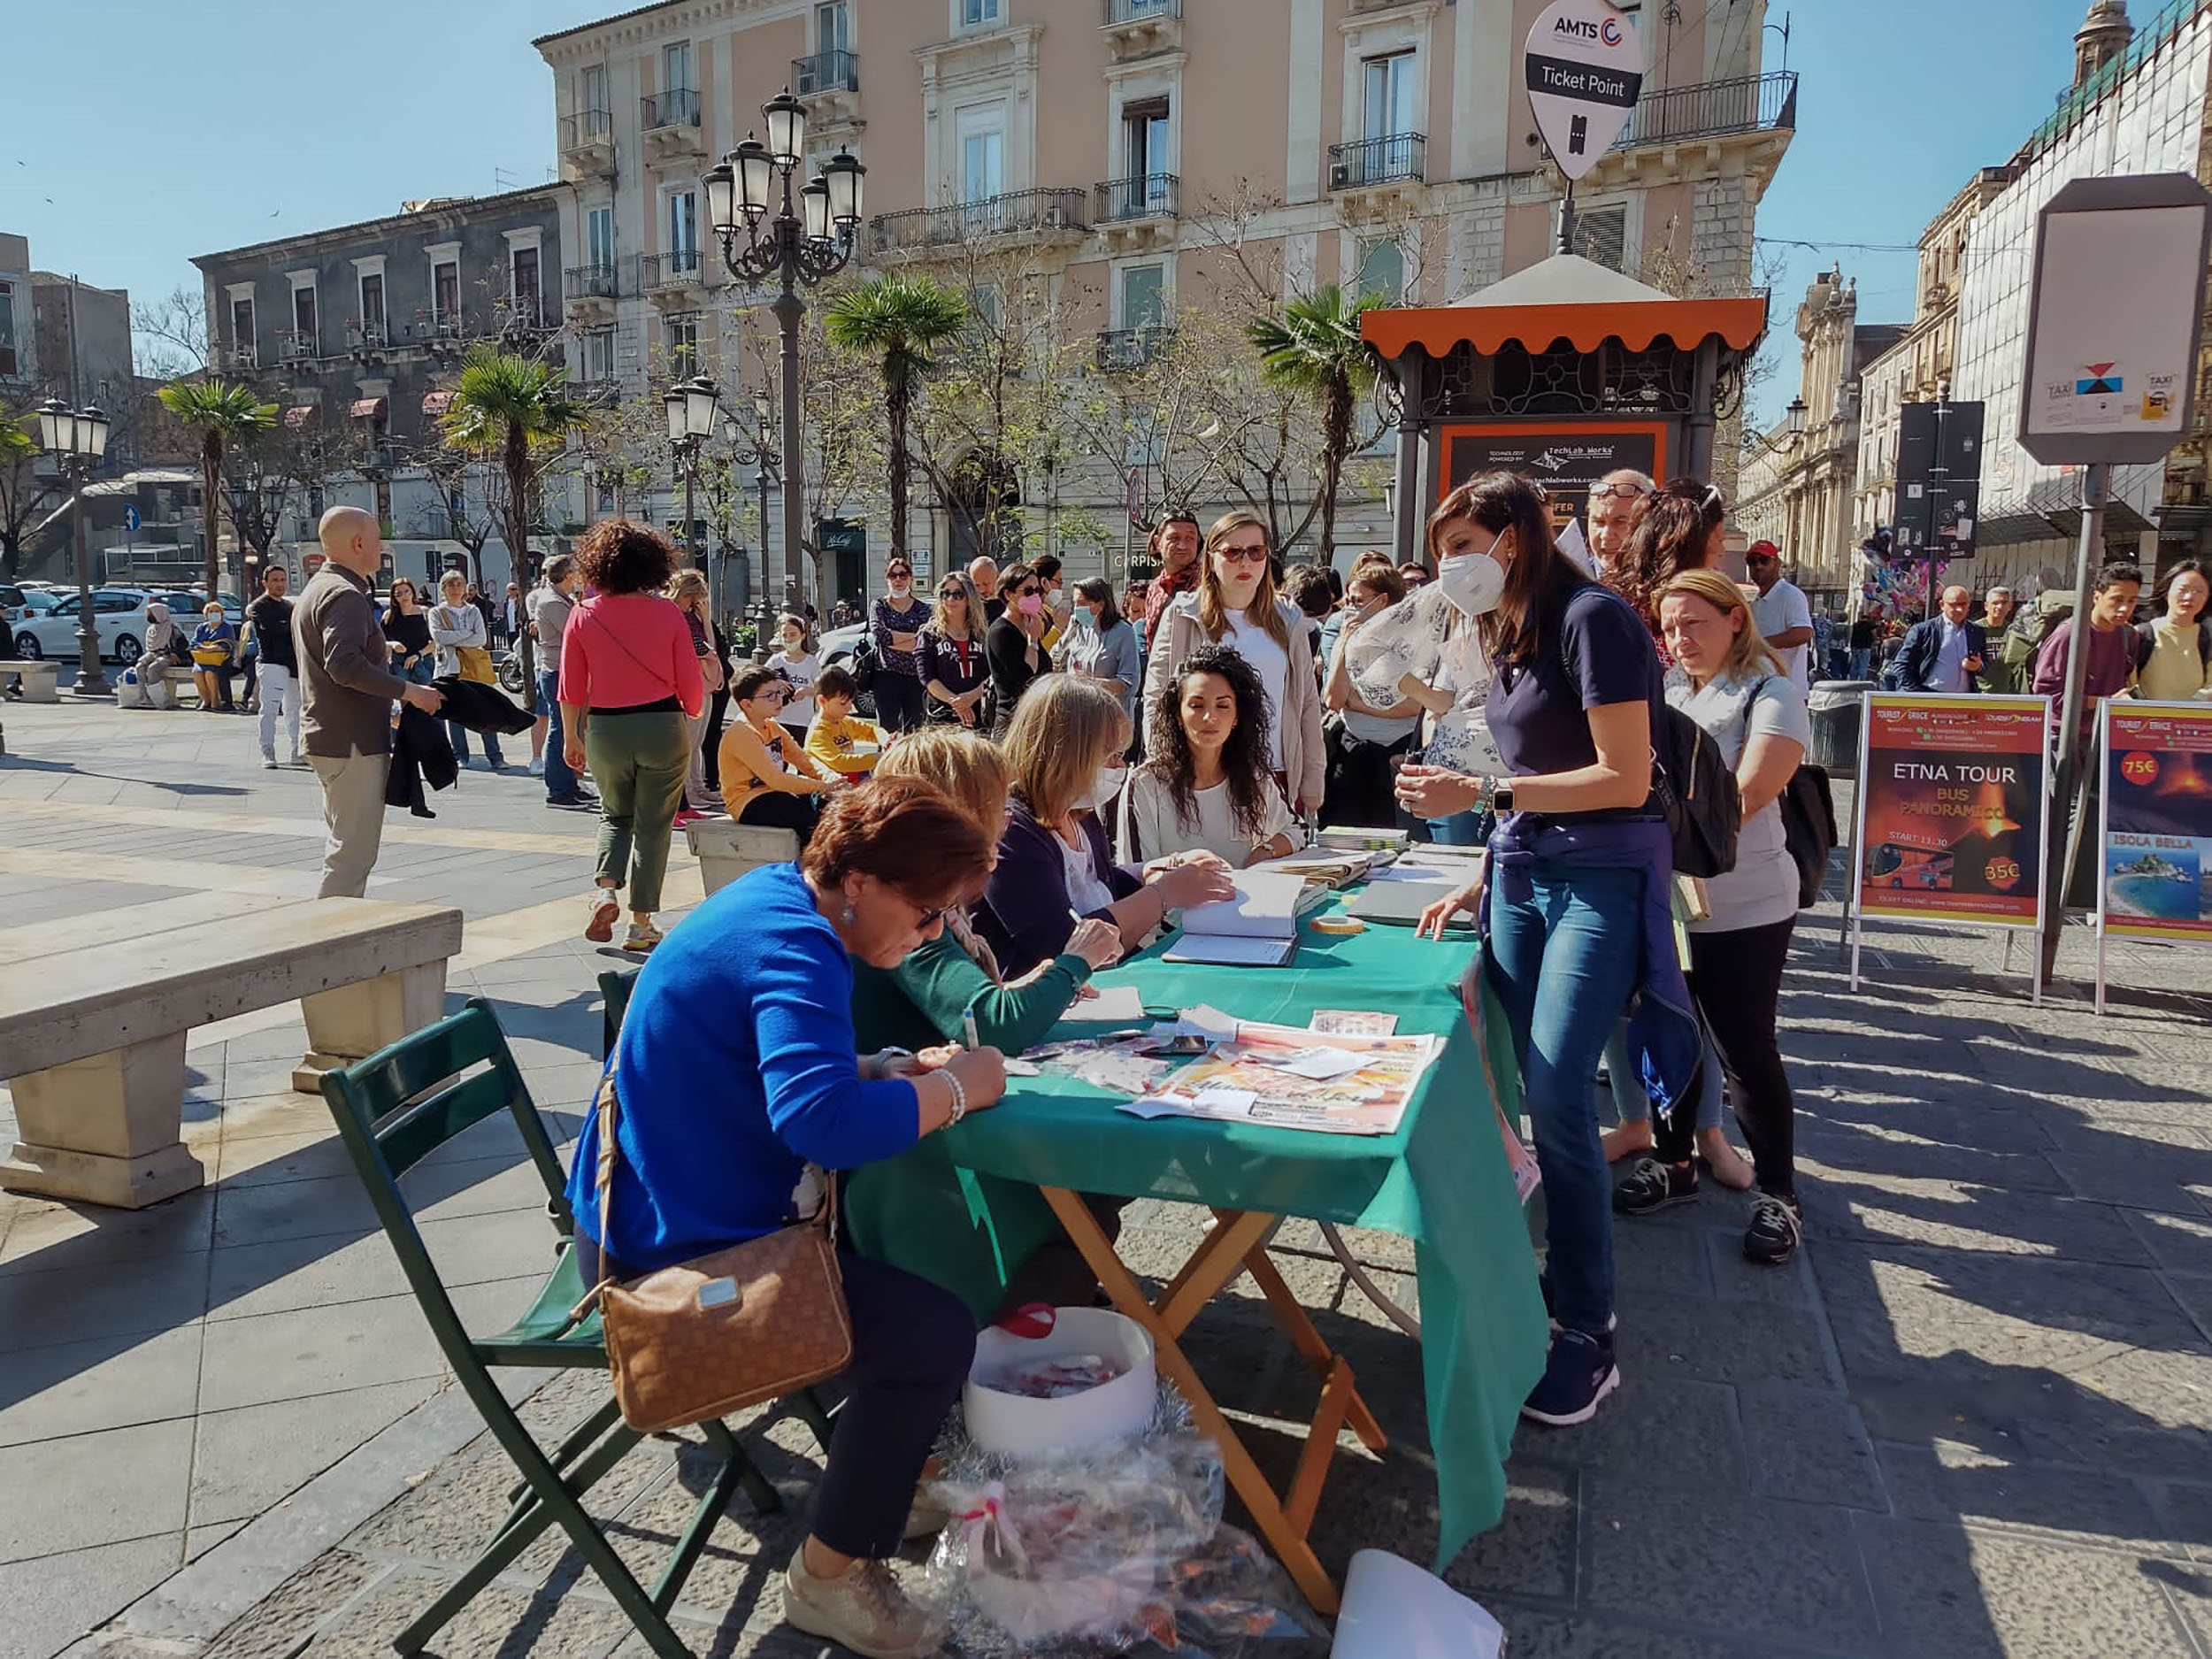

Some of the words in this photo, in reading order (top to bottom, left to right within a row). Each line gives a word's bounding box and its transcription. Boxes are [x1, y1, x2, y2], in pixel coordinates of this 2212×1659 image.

[1555, 18, 1597, 38] AMTS
[1542, 66, 1585, 89] Ticket
[1588, 75, 1625, 97] Point
[1114, 556, 1164, 567] CRPISA
[1893, 763, 1949, 781] ETNA
[1955, 765, 2016, 784] TOUR
[2124, 760, 2154, 774] 75€
[1937, 787, 1970, 802] BUS
[1900, 801, 2005, 819] PANORAMICO
[1888, 831, 1917, 841] START
[2114, 833, 2151, 847] ISOLA
[2155, 836, 2193, 849] BELLA
[1985, 863, 2021, 881] 35€
